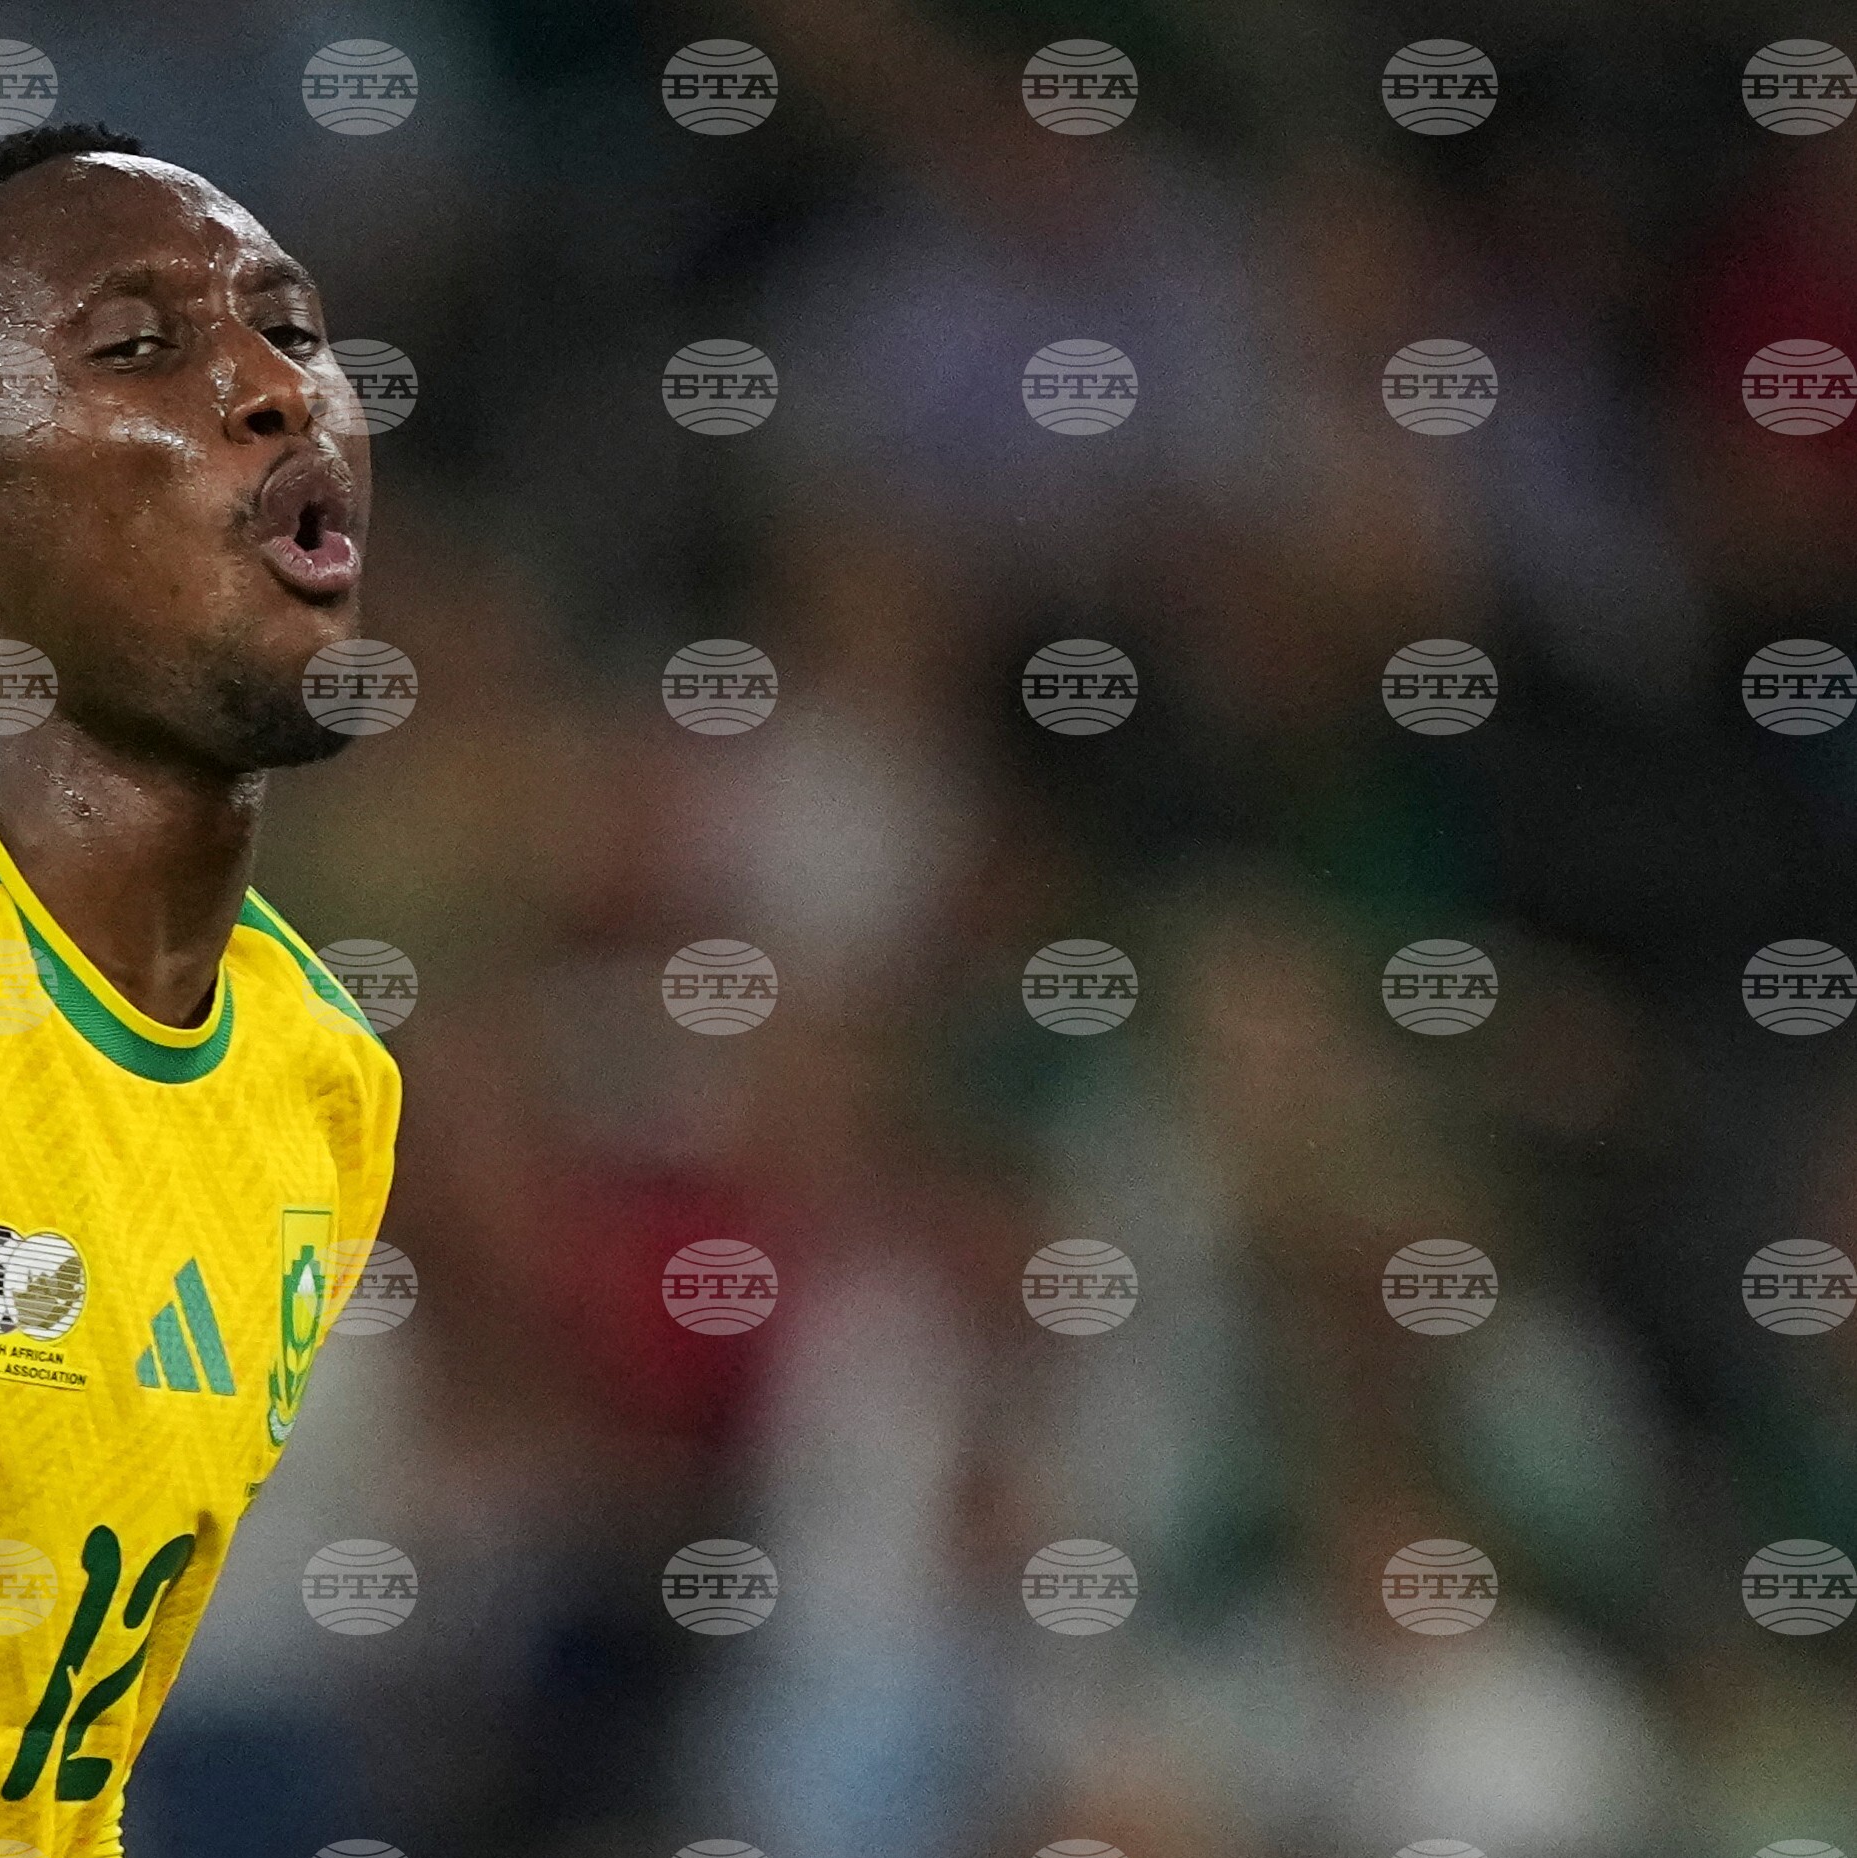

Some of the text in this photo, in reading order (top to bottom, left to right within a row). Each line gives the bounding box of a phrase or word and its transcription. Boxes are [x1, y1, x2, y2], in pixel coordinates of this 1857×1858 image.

[10, 1346, 64, 1365] AFRICAN
[4, 1364, 88, 1386] ASSOCIATION
[0, 1524, 196, 1801] 12
